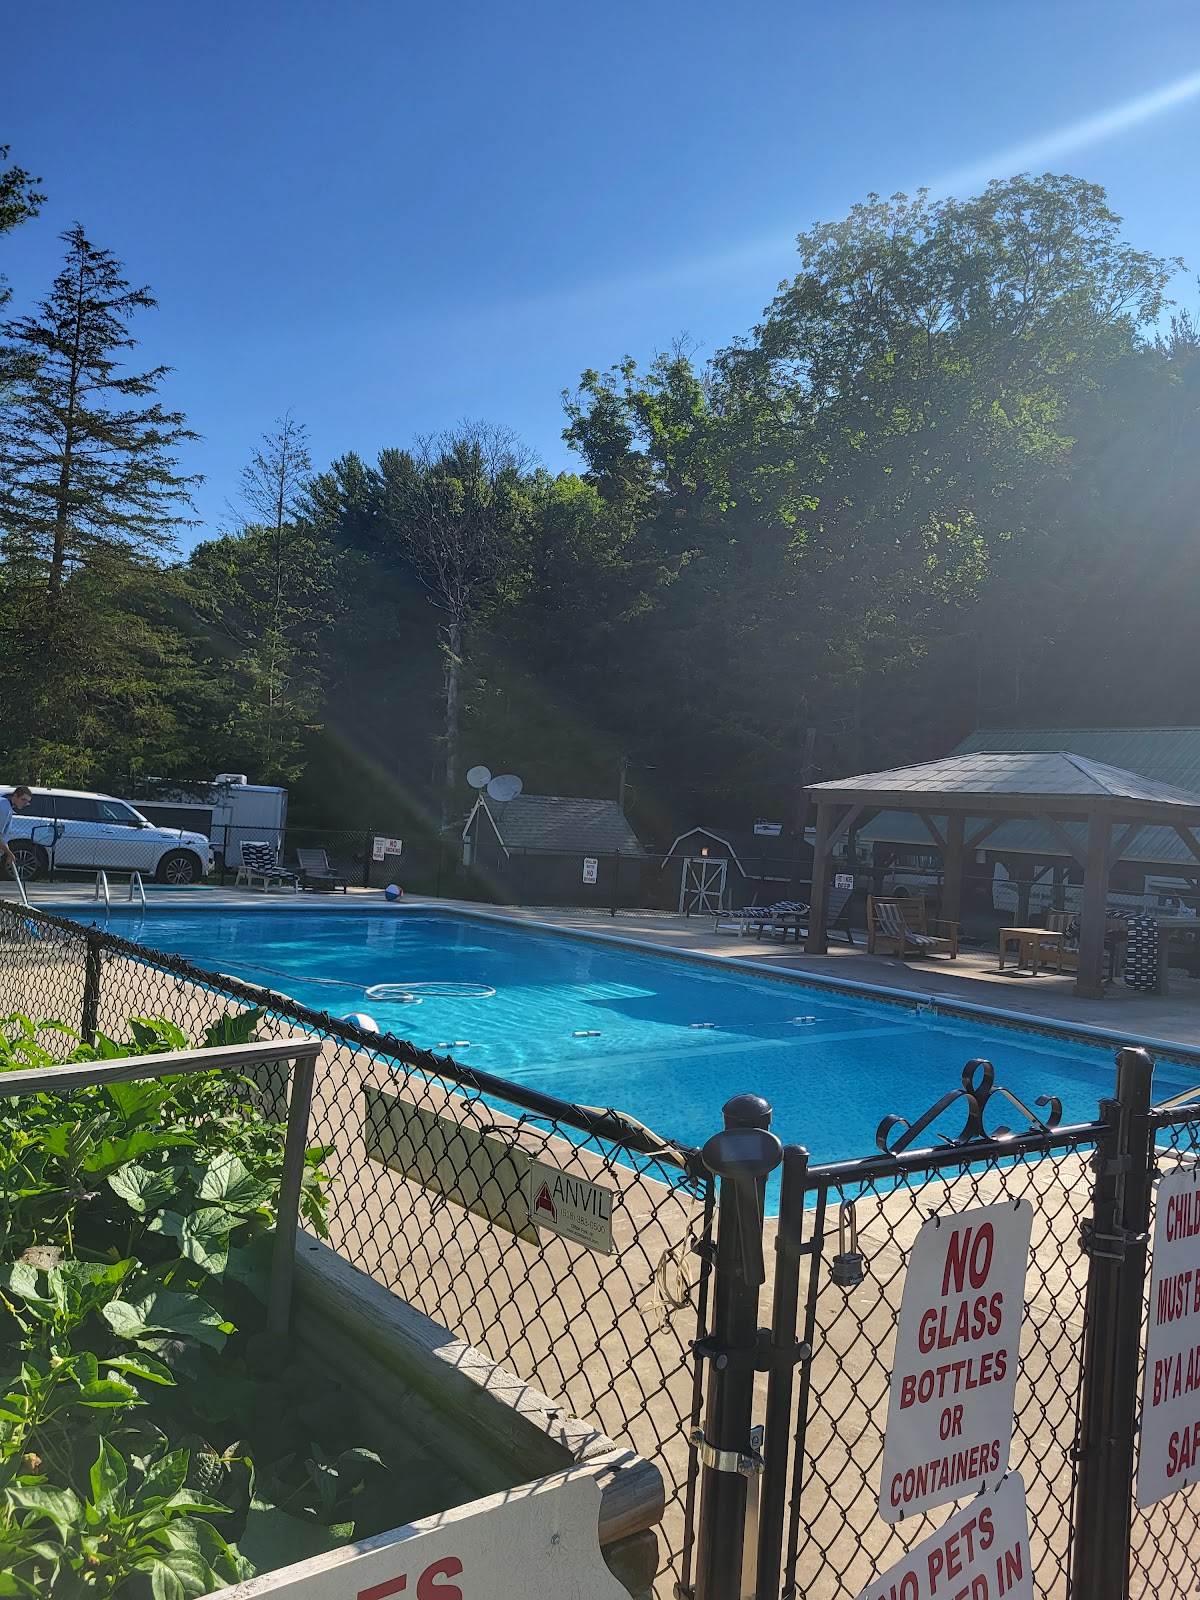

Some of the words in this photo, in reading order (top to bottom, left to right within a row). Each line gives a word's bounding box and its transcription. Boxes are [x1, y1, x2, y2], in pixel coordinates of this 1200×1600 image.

[553, 1175, 608, 1220] ANVIL
[941, 1222, 994, 1296] NO
[918, 1292, 1004, 1354] GLASS
[1156, 1270, 1192, 1326] MUST
[900, 1349, 1008, 1410] BOTTLES
[1152, 1356, 1173, 1407] BY
[1172, 1352, 1182, 1398] A
[939, 1404, 964, 1441] OR
[890, 1439, 1000, 1508] CONTAINERS
[928, 1507, 994, 1596] PETS
[996, 1541, 1023, 1598] IN
